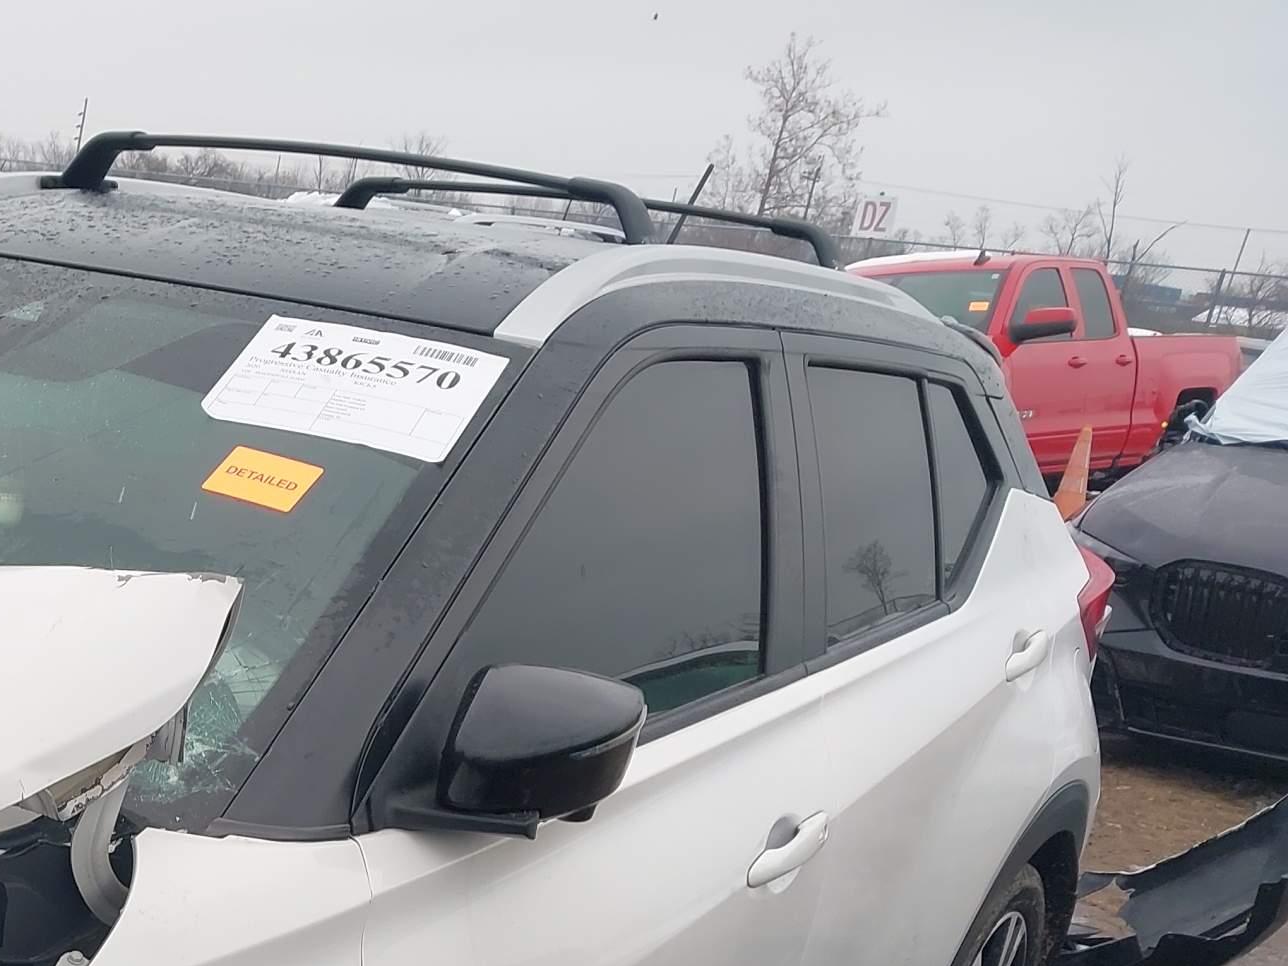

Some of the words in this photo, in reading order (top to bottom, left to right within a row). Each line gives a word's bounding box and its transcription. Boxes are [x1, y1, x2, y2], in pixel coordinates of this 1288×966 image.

[858, 200, 892, 233] DZ
[249, 355, 305, 371] Progressive
[306, 364, 347, 378] Casualty
[350, 372, 398, 386] Insurance
[270, 341, 462, 390] 43865570
[225, 464, 299, 493] DETAILED
